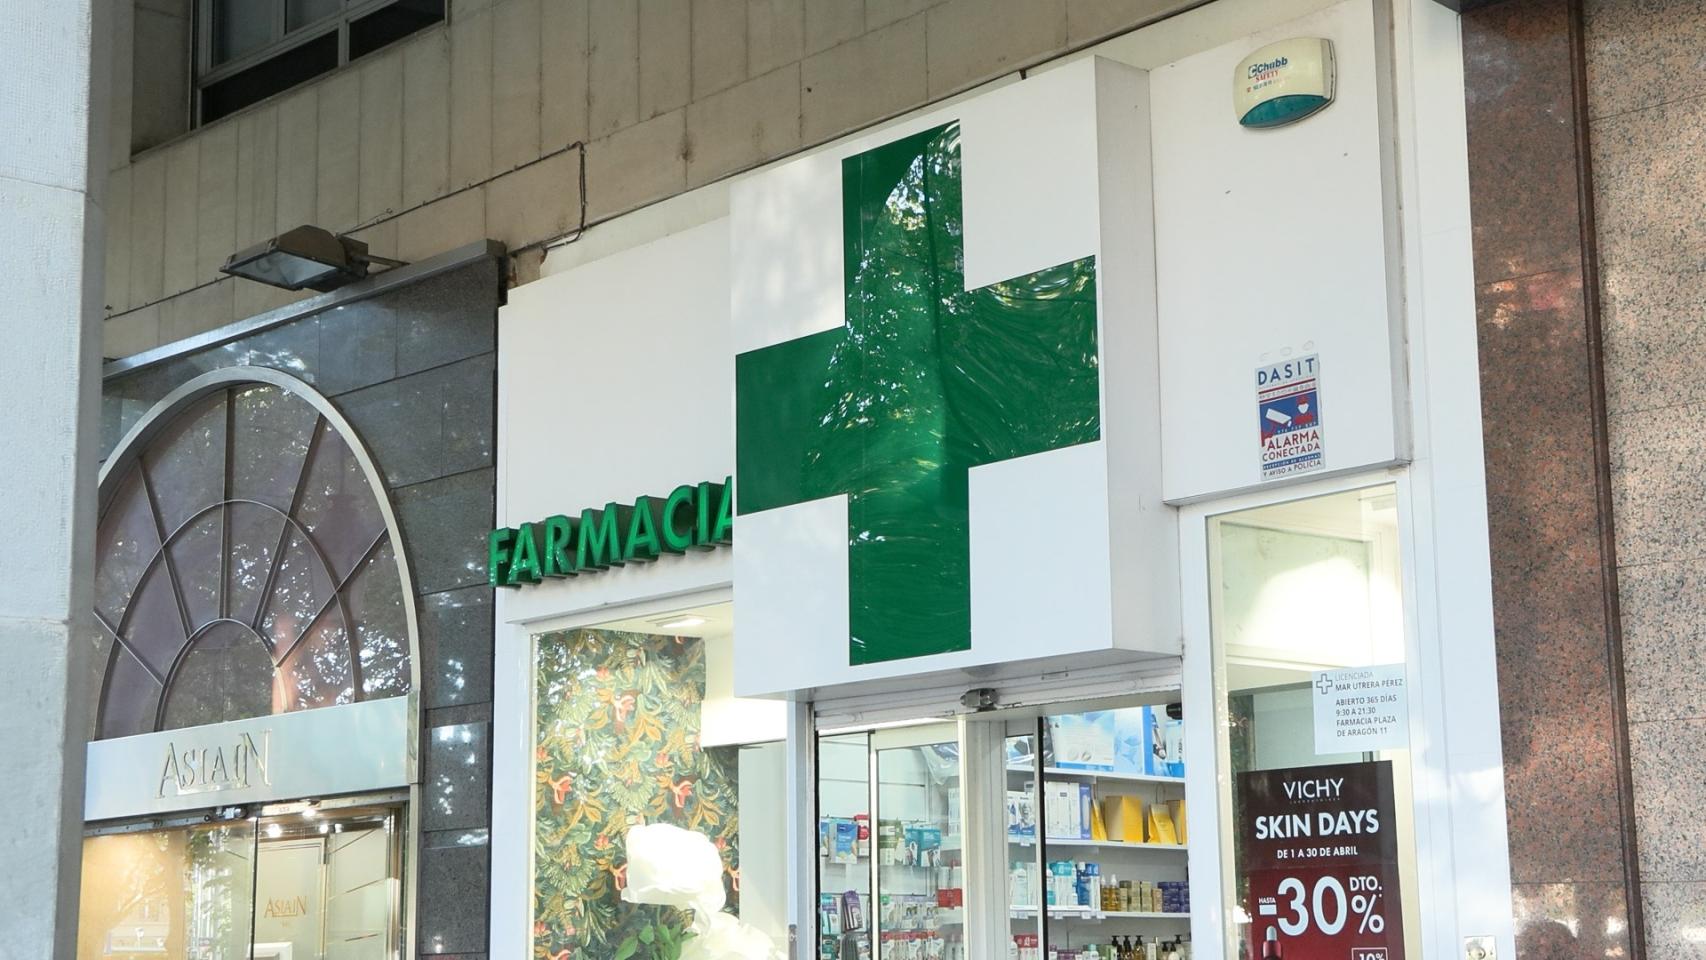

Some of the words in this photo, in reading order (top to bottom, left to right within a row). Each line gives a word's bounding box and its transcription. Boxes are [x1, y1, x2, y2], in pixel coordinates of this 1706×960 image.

[1256, 57, 1288, 74] Chubb
[1258, 358, 1315, 386] DASIT
[1267, 429, 1319, 451] ALARMA
[1262, 442, 1321, 462] CONECTADA
[1335, 671, 1373, 681] LICENCIADA
[1335, 682, 1351, 692] MAR
[1352, 680, 1380, 690] UTRERA
[1336, 697, 1365, 706] ABIERTO
[1366, 695, 1379, 704] 365
[1351, 708, 1357, 716] A
[1336, 717, 1372, 727] FARMACIA
[1374, 715, 1397, 725] PLAZA
[1337, 729, 1345, 737] DE
[1380, 727, 1387, 735] 11
[1283, 778, 1344, 799] VICHY
[1255, 813, 1312, 840] SKIN
[1318, 808, 1380, 836] DAYS
[1277, 849, 1288, 859] DE
[1291, 849, 1295, 858] 1
[1297, 848, 1305, 858] A
[1306, 847, 1318, 857] 30
[1319, 847, 1331, 857] DE
[1333, 846, 1358, 856] ABRIL
[1258, 896, 1276, 904] HASTA
